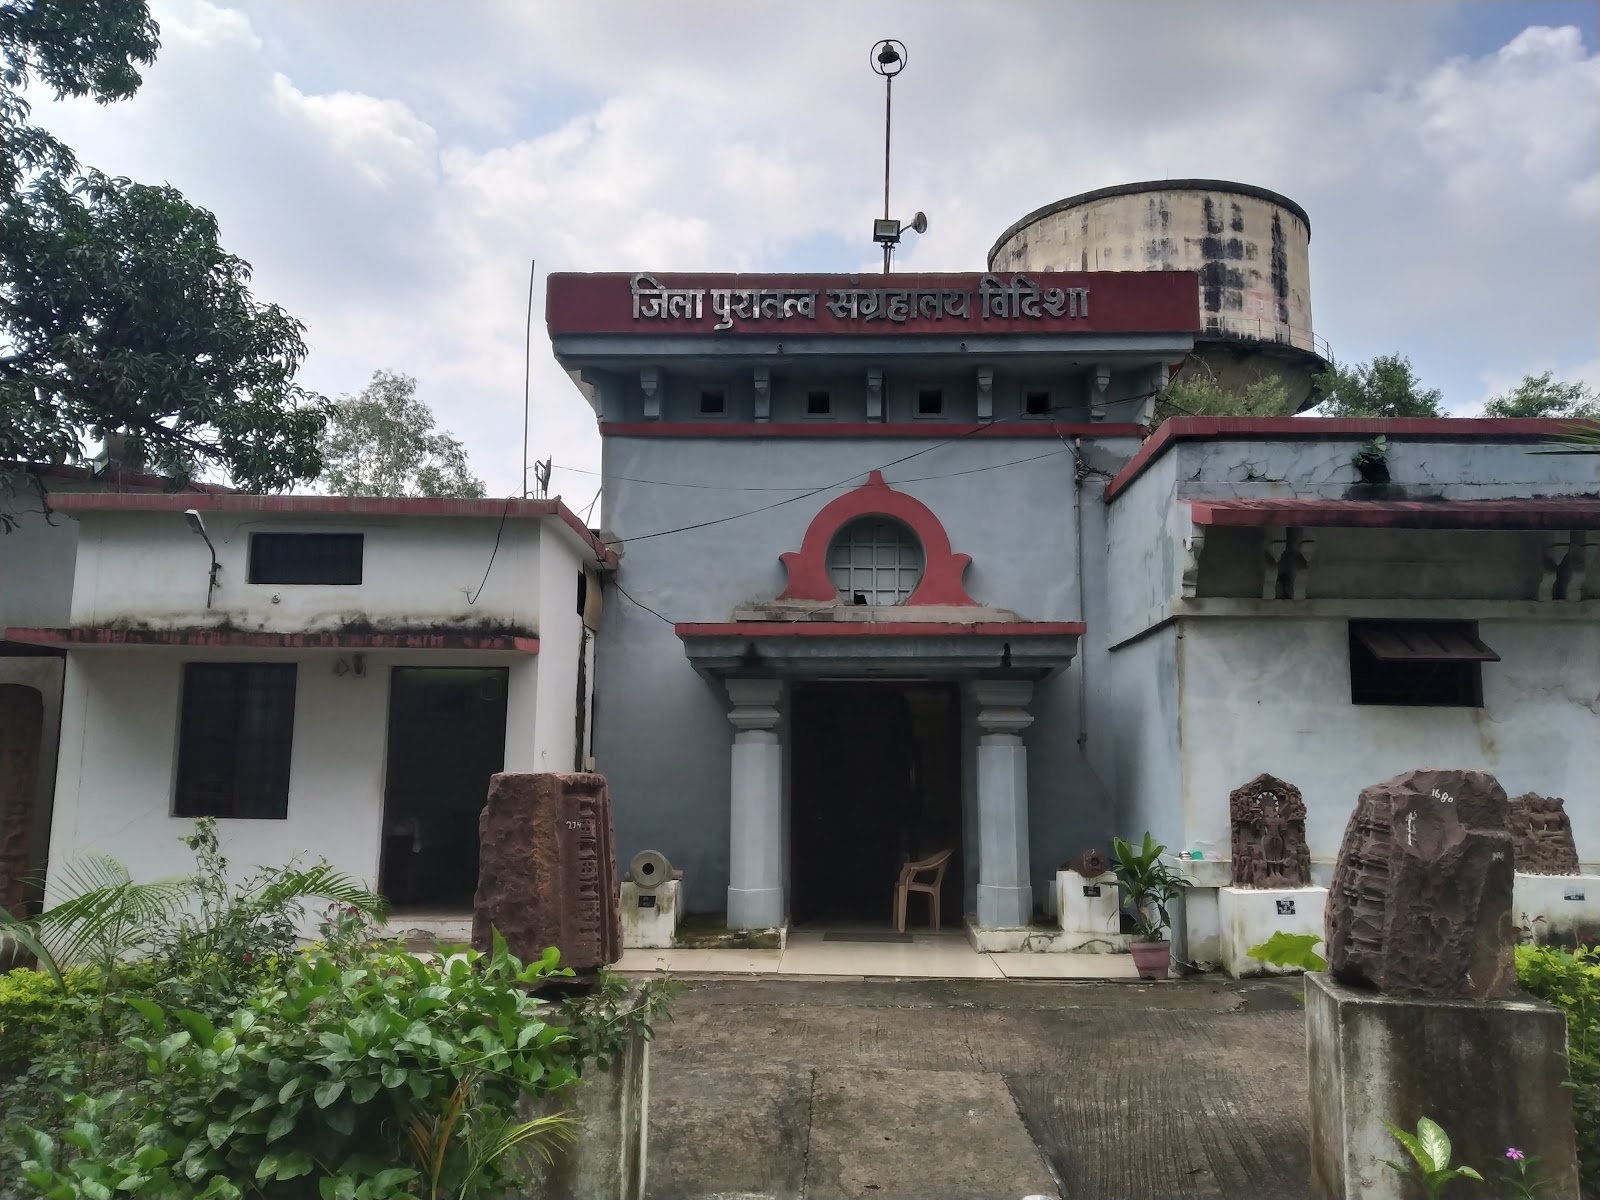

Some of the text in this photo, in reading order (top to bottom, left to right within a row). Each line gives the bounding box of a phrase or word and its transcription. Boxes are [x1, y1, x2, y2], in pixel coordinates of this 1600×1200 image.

[630, 272, 1090, 330] जिला पुरातत्व संग्रहालय विदिशा
[1431, 788, 1454, 803] 1680
